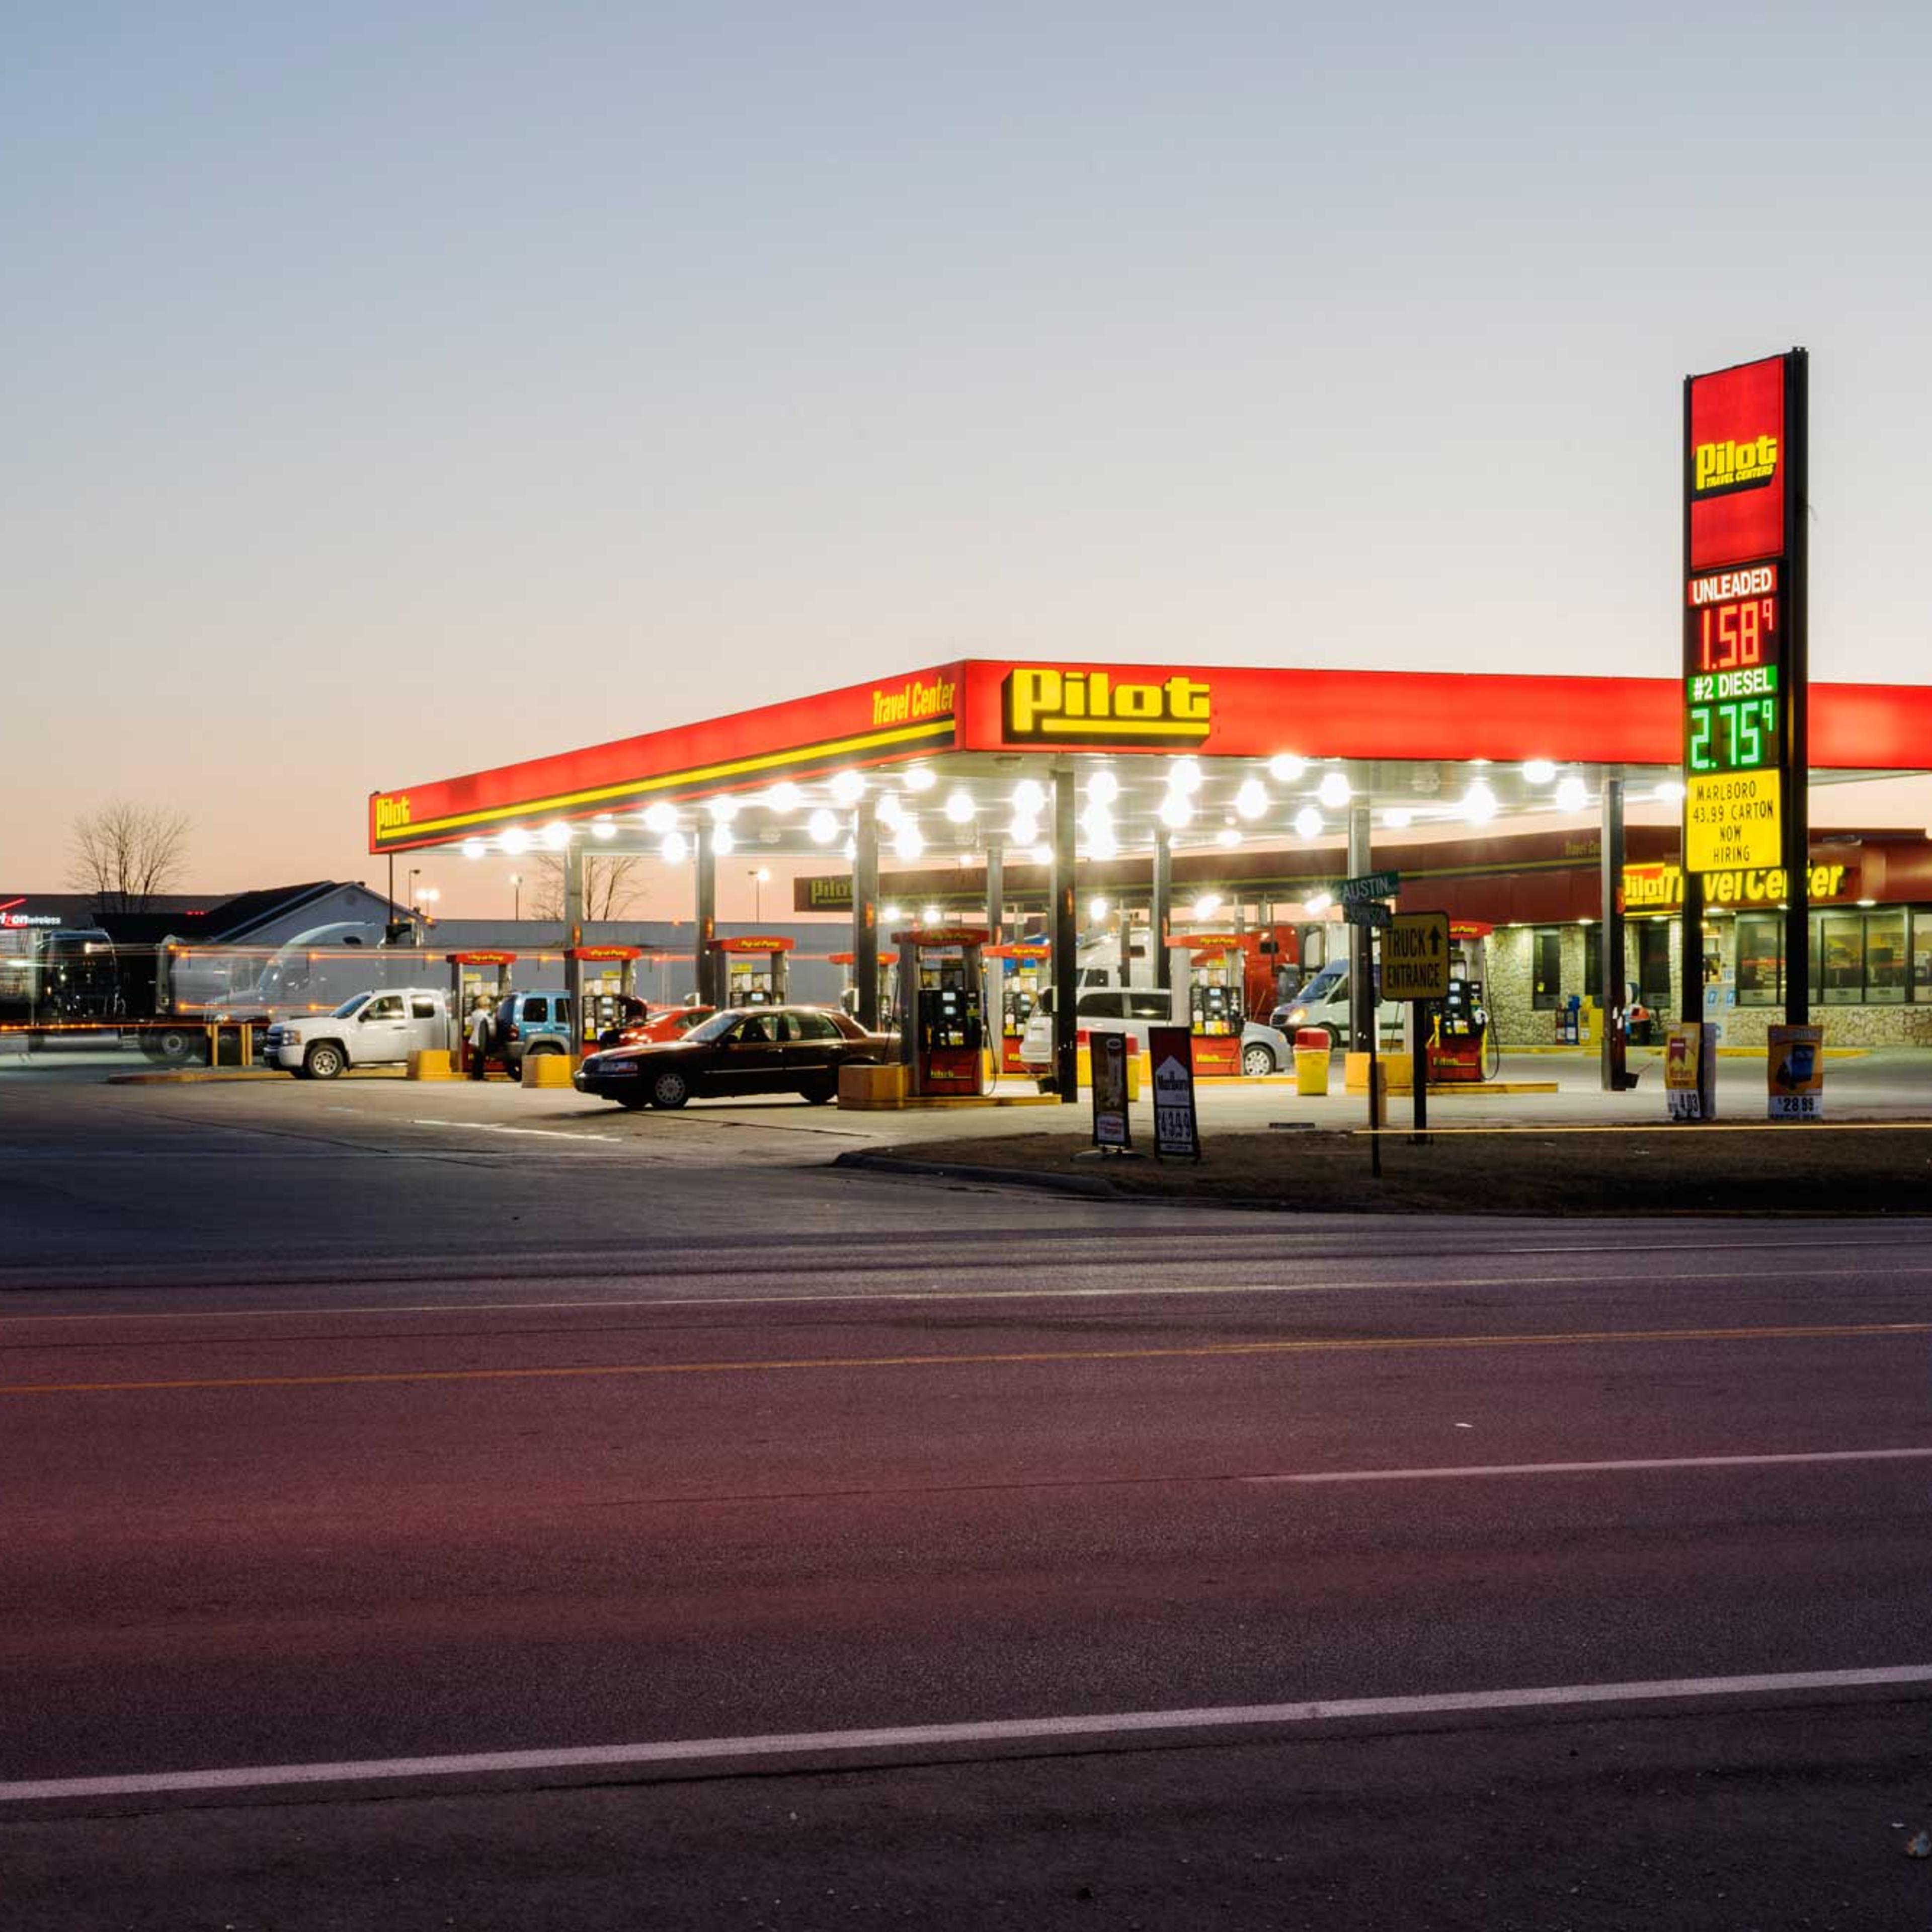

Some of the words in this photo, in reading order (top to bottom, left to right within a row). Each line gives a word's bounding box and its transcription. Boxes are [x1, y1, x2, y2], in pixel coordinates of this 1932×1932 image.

[1696, 435, 1777, 490] Pilot
[1707, 472, 1734, 488] TRAVEL
[1736, 464, 1774, 482] CENTERS
[1693, 567, 1772, 604] UNLEADED
[1694, 677, 1713, 701] #2
[1718, 668, 1773, 698] DIESEL
[872, 683, 910, 726] Travel
[912, 676, 955, 717] Center
[1012, 669, 1210, 732] Pilot
[1696, 780, 1756, 802] MARLBORO
[376, 796, 410, 840] Pilot
[1693, 806, 1725, 823] 43.99
[1731, 799, 1774, 821] CARTON
[1719, 824, 1742, 842] NOW
[1714, 845, 1750, 863] HIRING
[811, 877, 854, 904] Pilo
[1341, 876, 1389, 904] AUSTIN
[1662, 866, 1743, 903] Trvel
[1386, 927, 1426, 957] TRUCK
[1387, 961, 1441, 989] ENTRANCE
